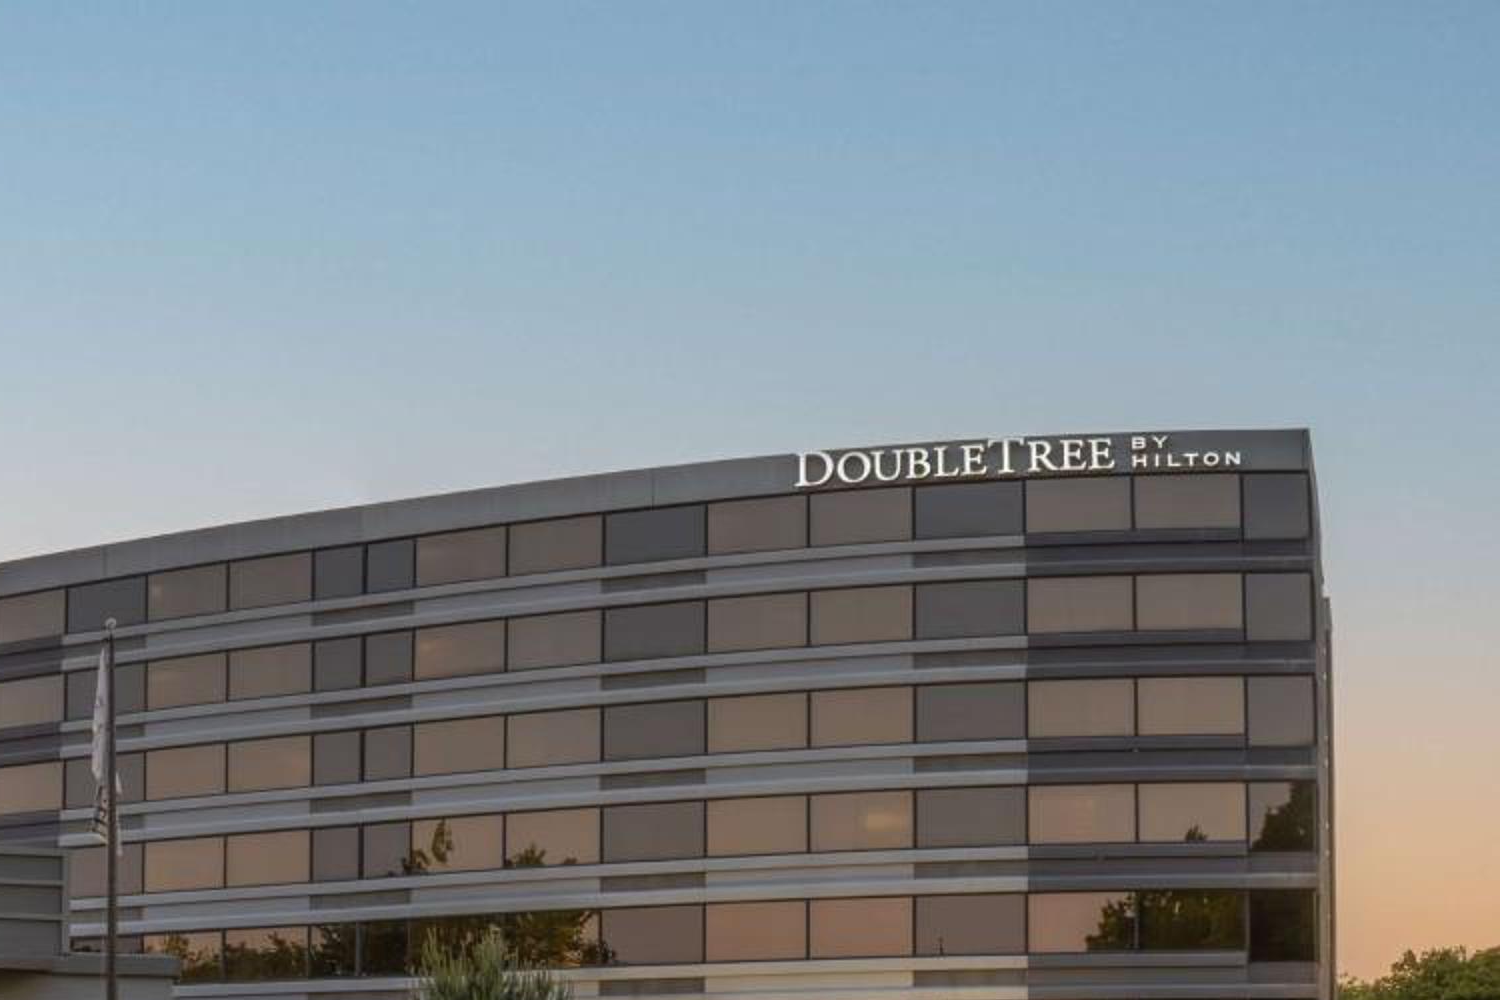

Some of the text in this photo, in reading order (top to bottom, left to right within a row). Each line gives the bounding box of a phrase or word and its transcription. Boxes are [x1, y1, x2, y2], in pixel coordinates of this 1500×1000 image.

[1131, 435, 1168, 449] BY
[795, 437, 1115, 487] DOUBLETREE
[1131, 452, 1241, 467] HILTON
